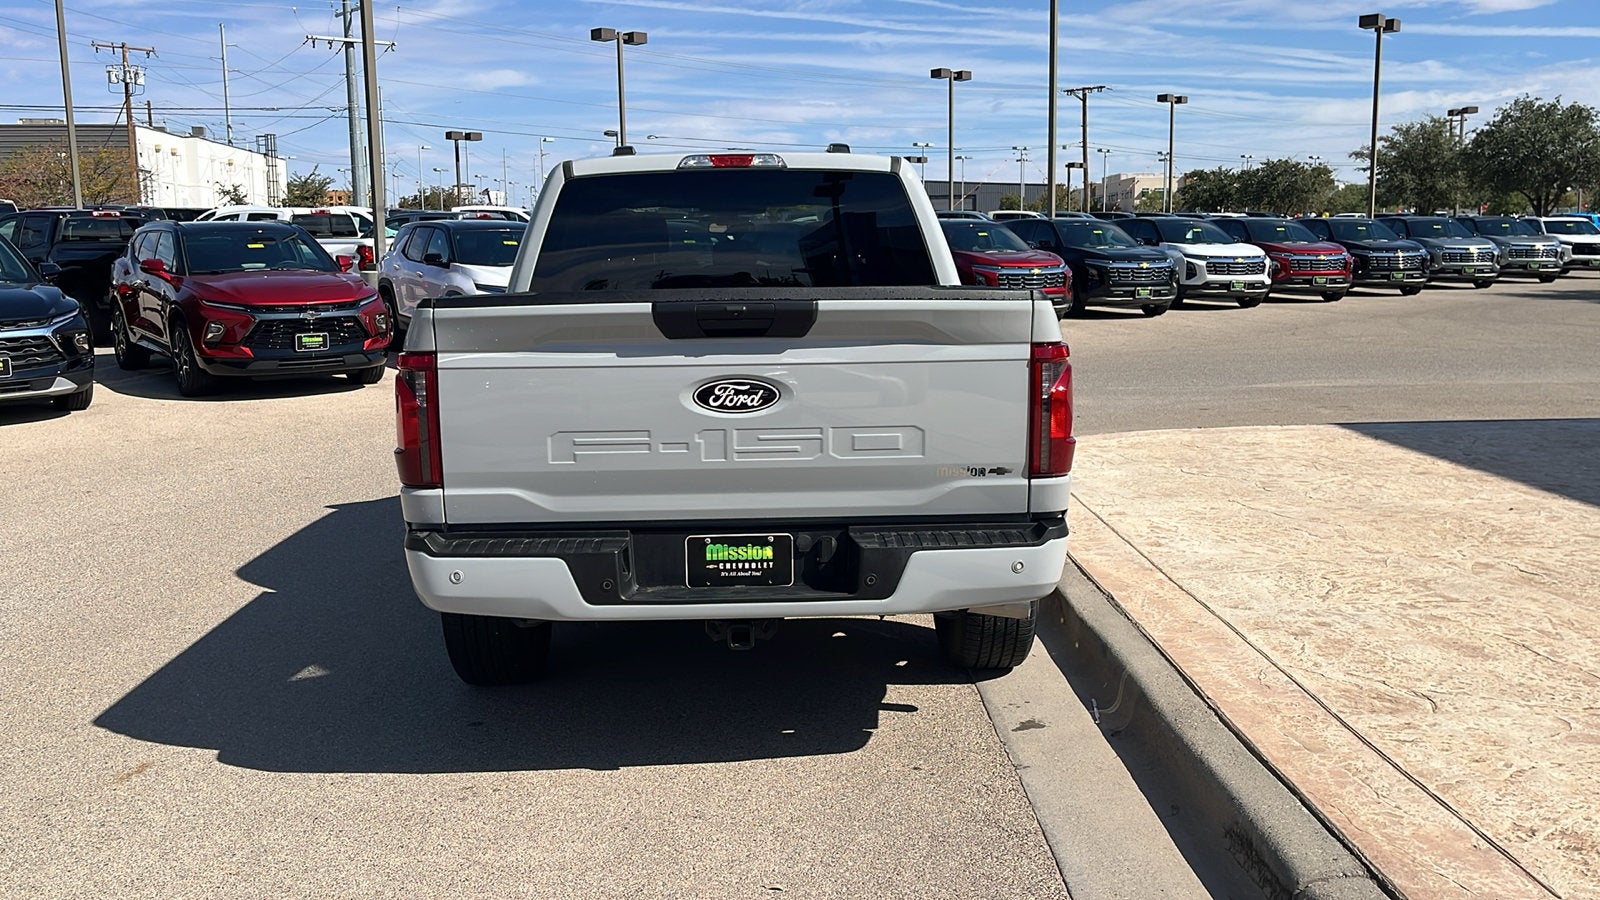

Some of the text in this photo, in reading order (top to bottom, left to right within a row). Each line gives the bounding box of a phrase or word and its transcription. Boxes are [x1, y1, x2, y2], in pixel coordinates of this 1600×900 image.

[708, 384, 764, 407] Ford
[547, 425, 926, 464] F-150
[706, 544, 773, 560] Mission
